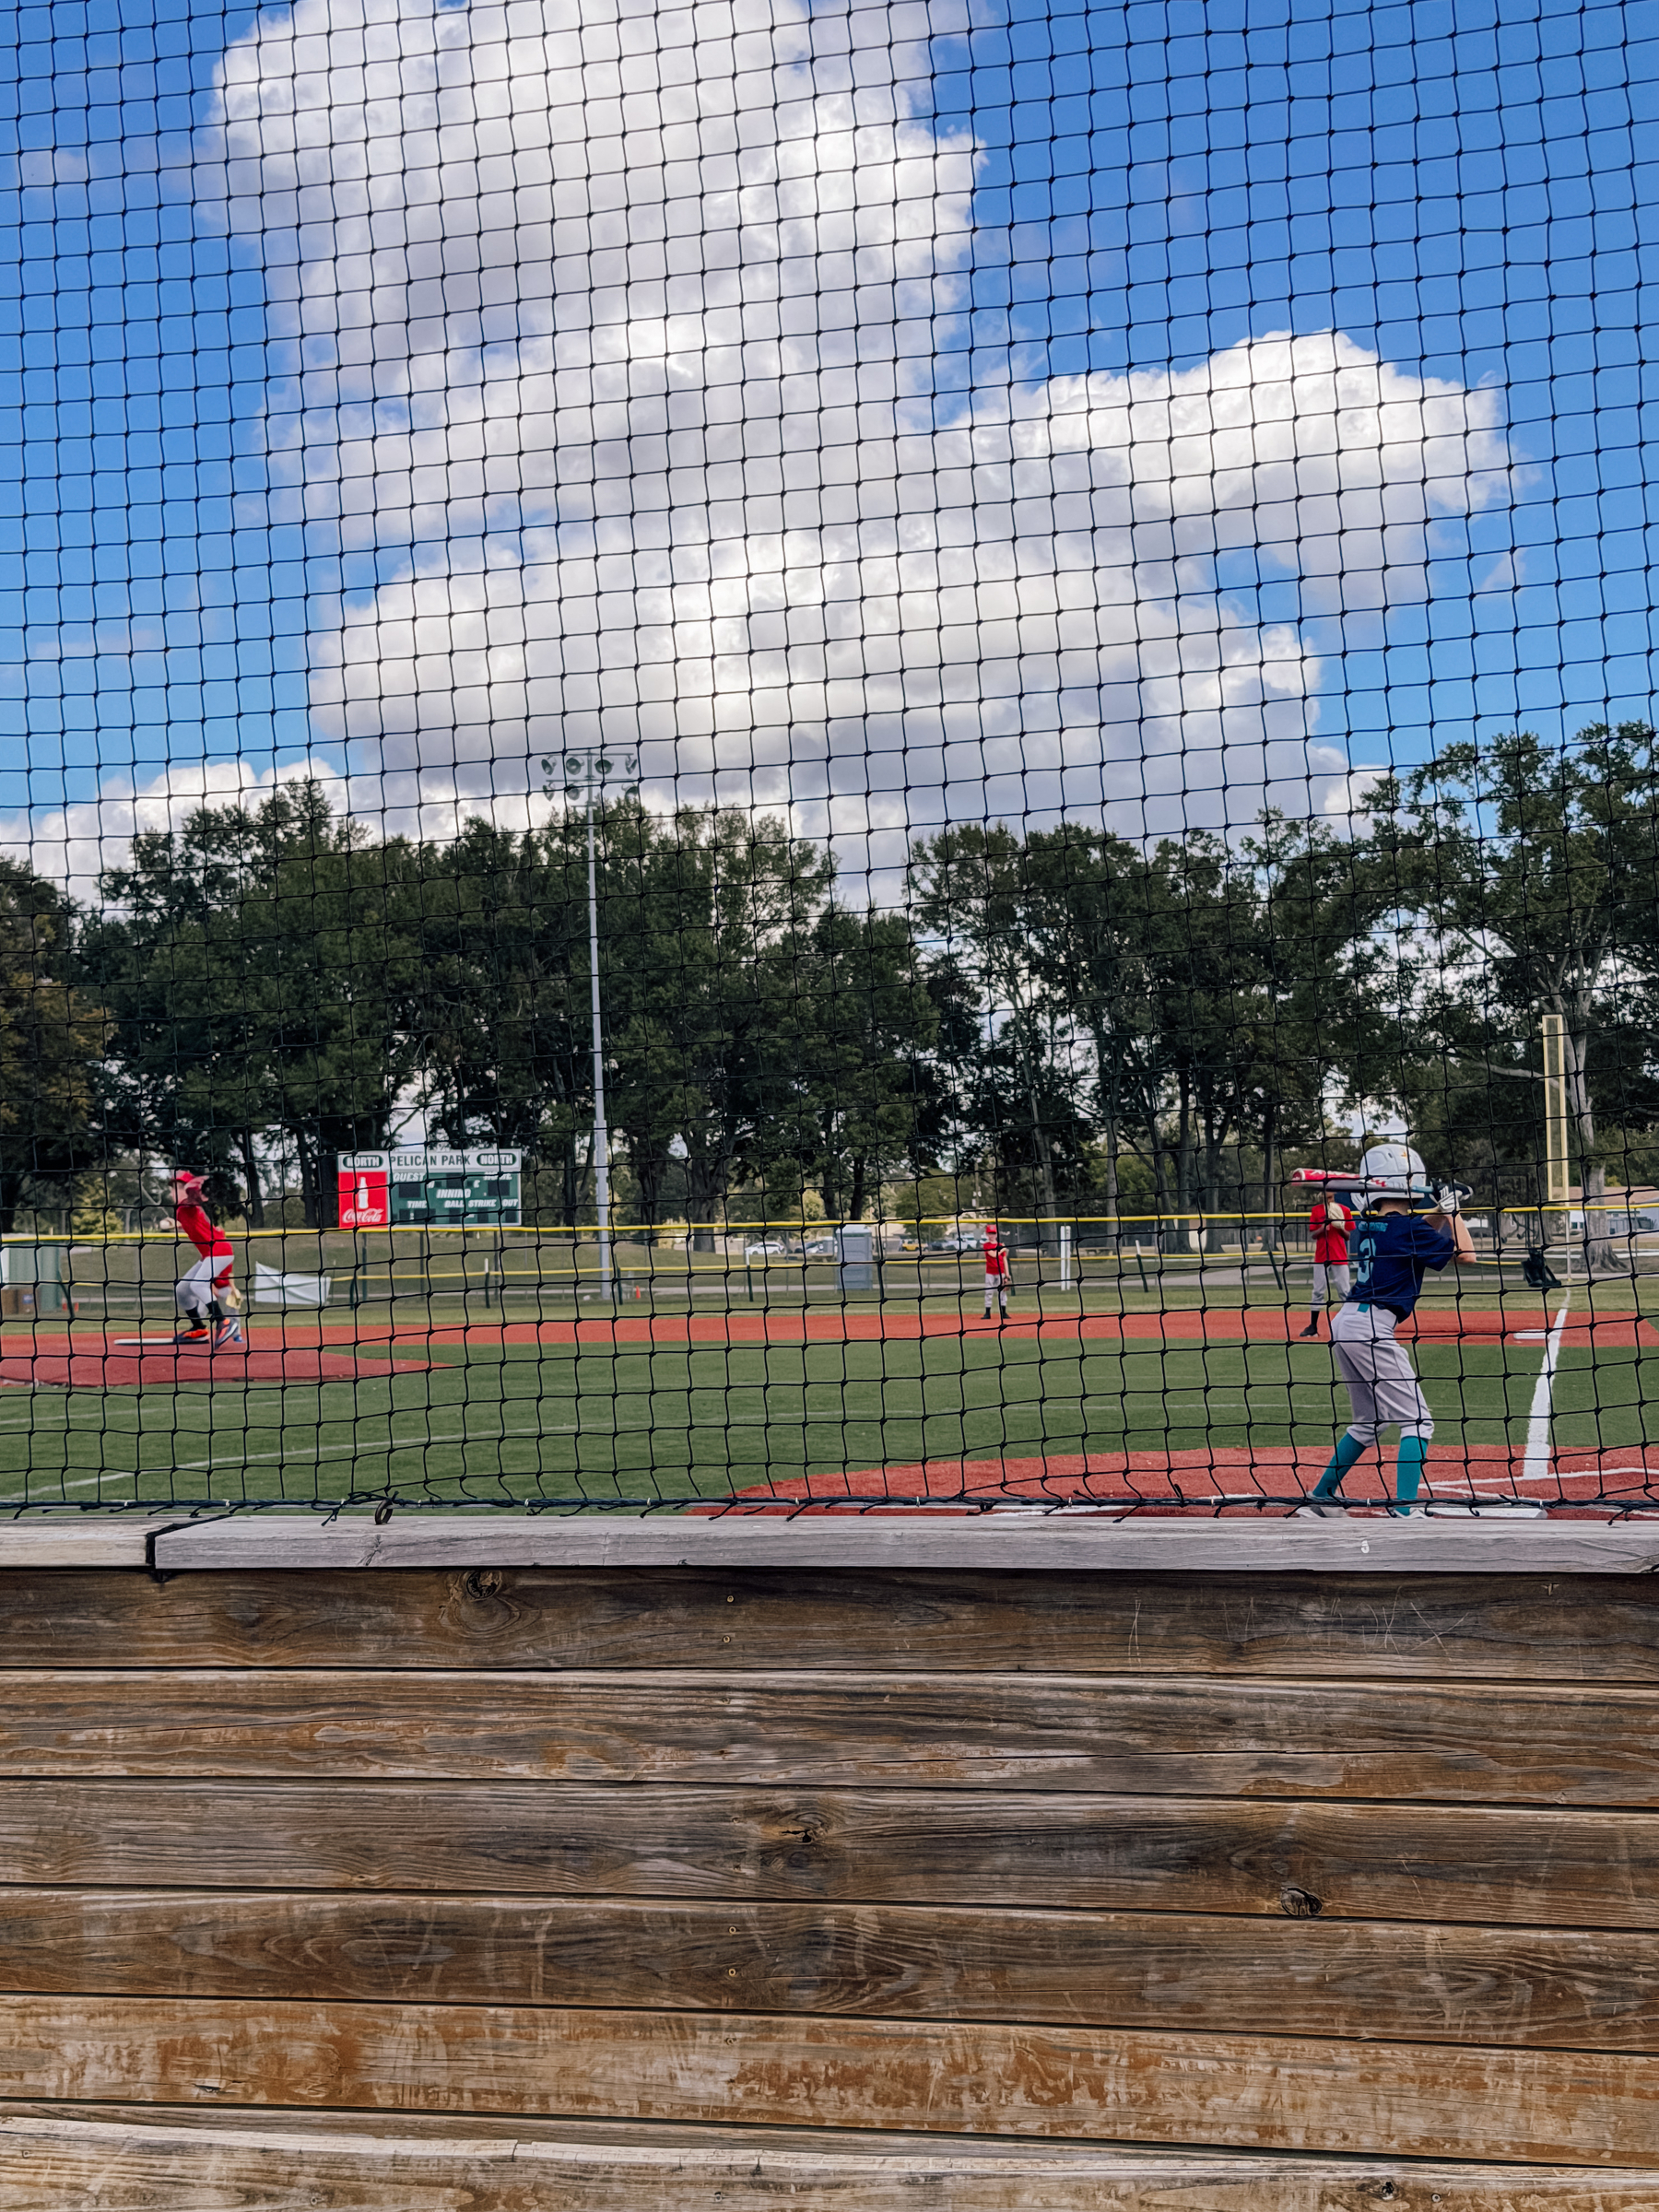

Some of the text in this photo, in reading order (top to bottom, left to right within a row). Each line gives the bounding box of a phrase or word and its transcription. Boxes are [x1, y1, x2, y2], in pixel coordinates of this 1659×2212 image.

[347, 1156, 380, 1167] NORTH
[389, 1155, 471, 1166] PELICAN PARK
[480, 1154, 513, 1165] NORTH
[393, 1172, 425, 1182] GUEST
[436, 1188, 472, 1198] INNING
[406, 1200, 428, 1208] TIME
[443, 1200, 465, 1208] BALL
[468, 1199, 498, 1208] STRIKE
[501, 1199, 519, 1207] OUT
[1358, 1238, 1377, 1284] 3
